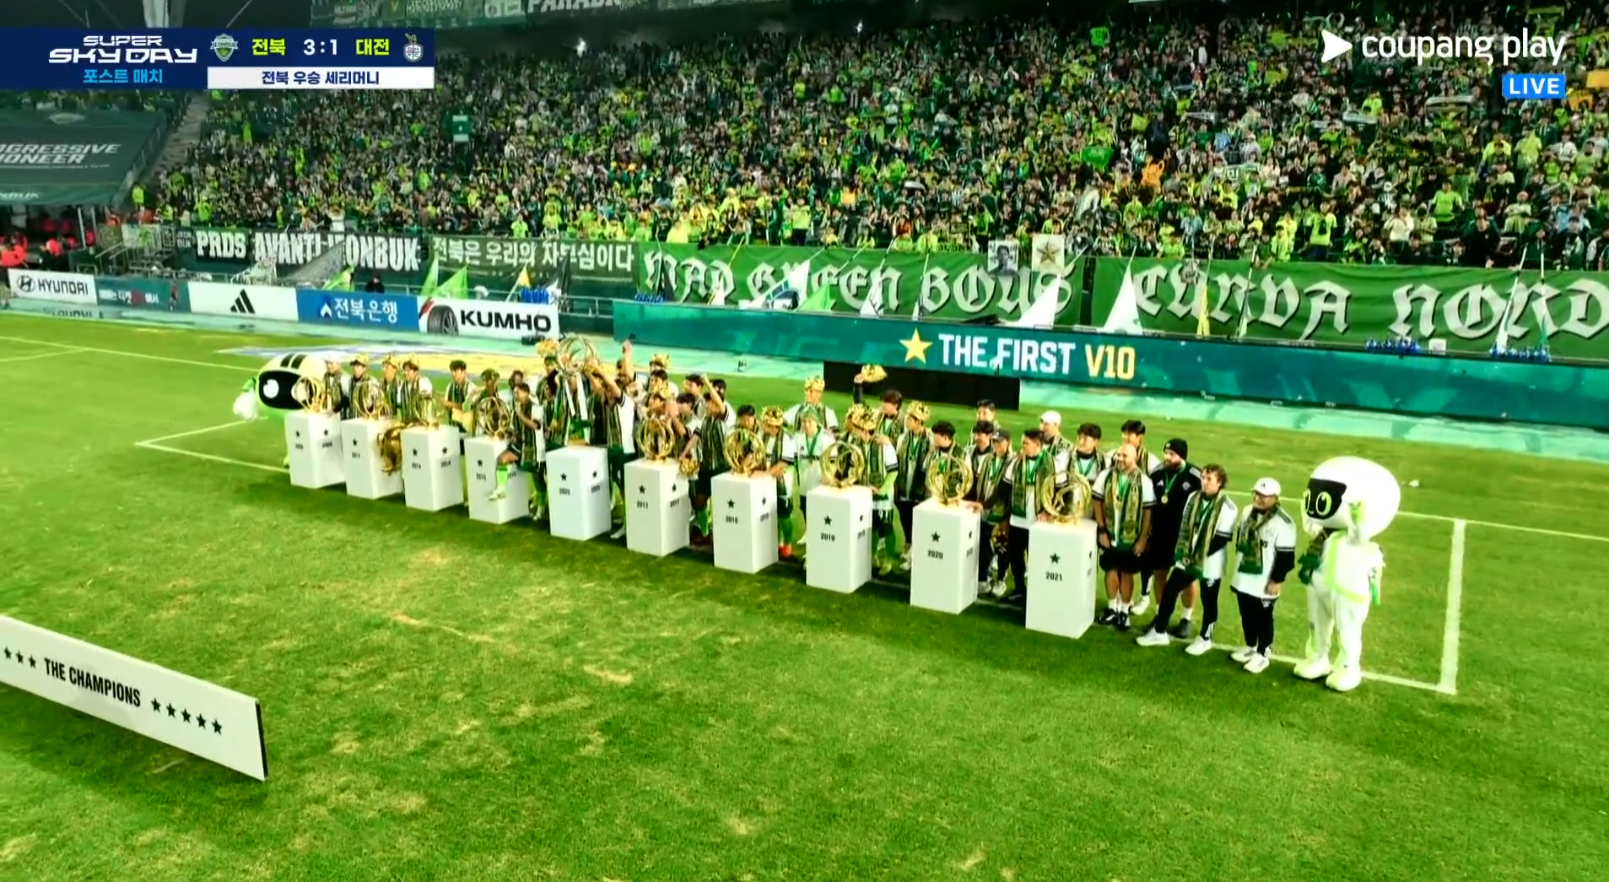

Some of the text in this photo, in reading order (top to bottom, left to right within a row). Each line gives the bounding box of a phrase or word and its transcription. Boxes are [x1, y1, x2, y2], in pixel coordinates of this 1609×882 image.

[196, 230, 247, 259] PRDS
[486, 239, 536, 267] 우리의
[37, 278, 89, 296] HYUNDAI
[334, 297, 398, 324] 전북은행
[460, 309, 552, 333] KUMHO
[938, 333, 1136, 380] THE FIRST V10
[927, 549, 944, 560] 2020
[1045, 570, 1063, 582] 2021
[43, 657, 141, 708] THE CHAMPIONS
